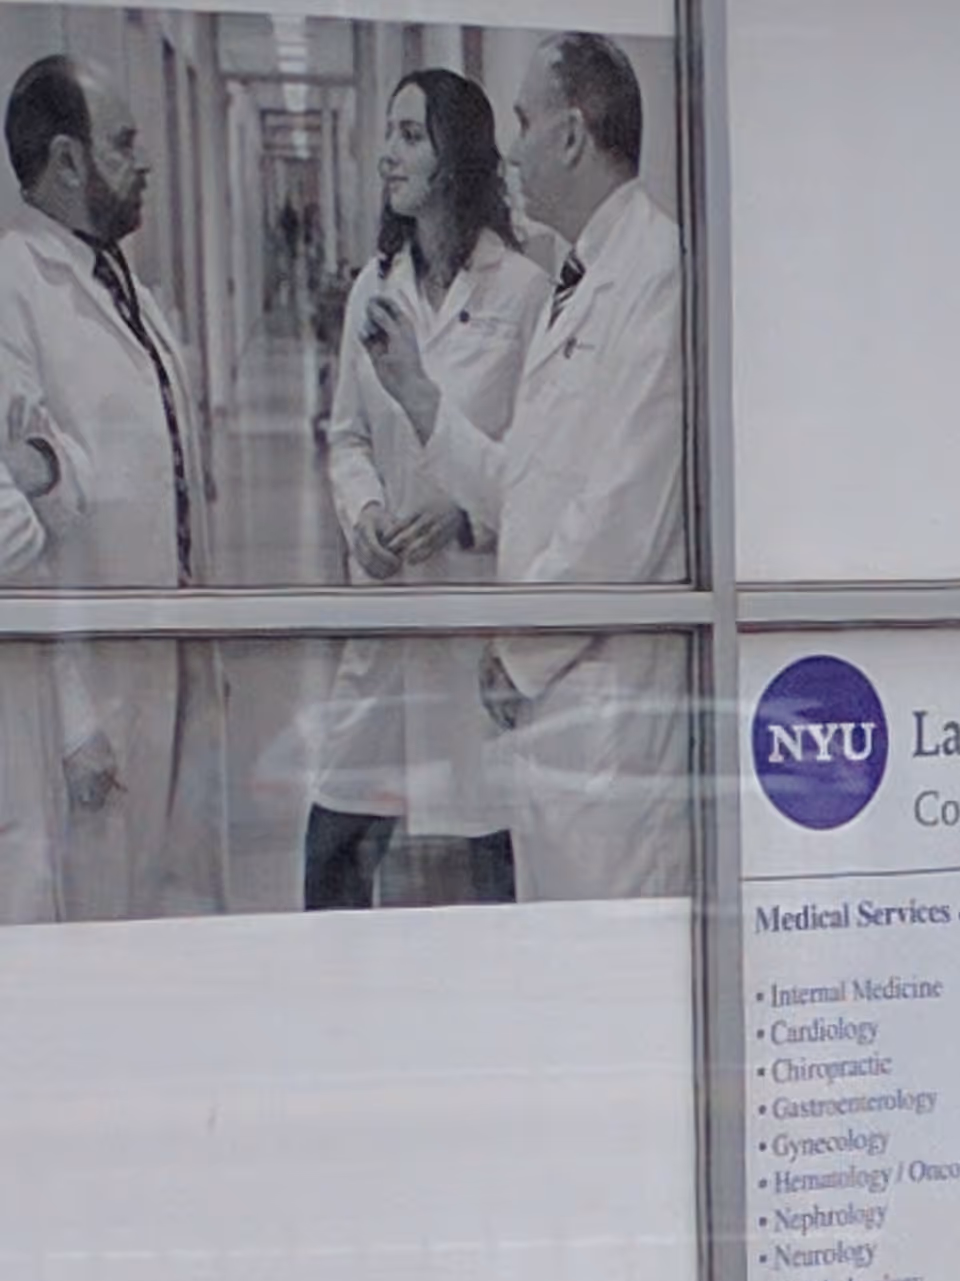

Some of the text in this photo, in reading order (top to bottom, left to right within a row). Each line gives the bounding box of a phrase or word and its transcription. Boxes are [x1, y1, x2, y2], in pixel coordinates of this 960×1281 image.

[767, 722, 877, 764] NYU
[755, 903, 850, 933] Medical
[856, 898, 951, 927] Services
[771, 975, 944, 1008] Internal Medicine
[770, 1017, 879, 1045] Cardiology
[771, 1051, 893, 1085] Chiropractic
[772, 1089, 938, 1120] Gastroenterology
[772, 1128, 889, 1163] Gynecology
[773, 1165, 893, 1194] Hematology
[774, 1202, 887, 1236] Nephrology
[773, 1241, 877, 1270] Neurology
